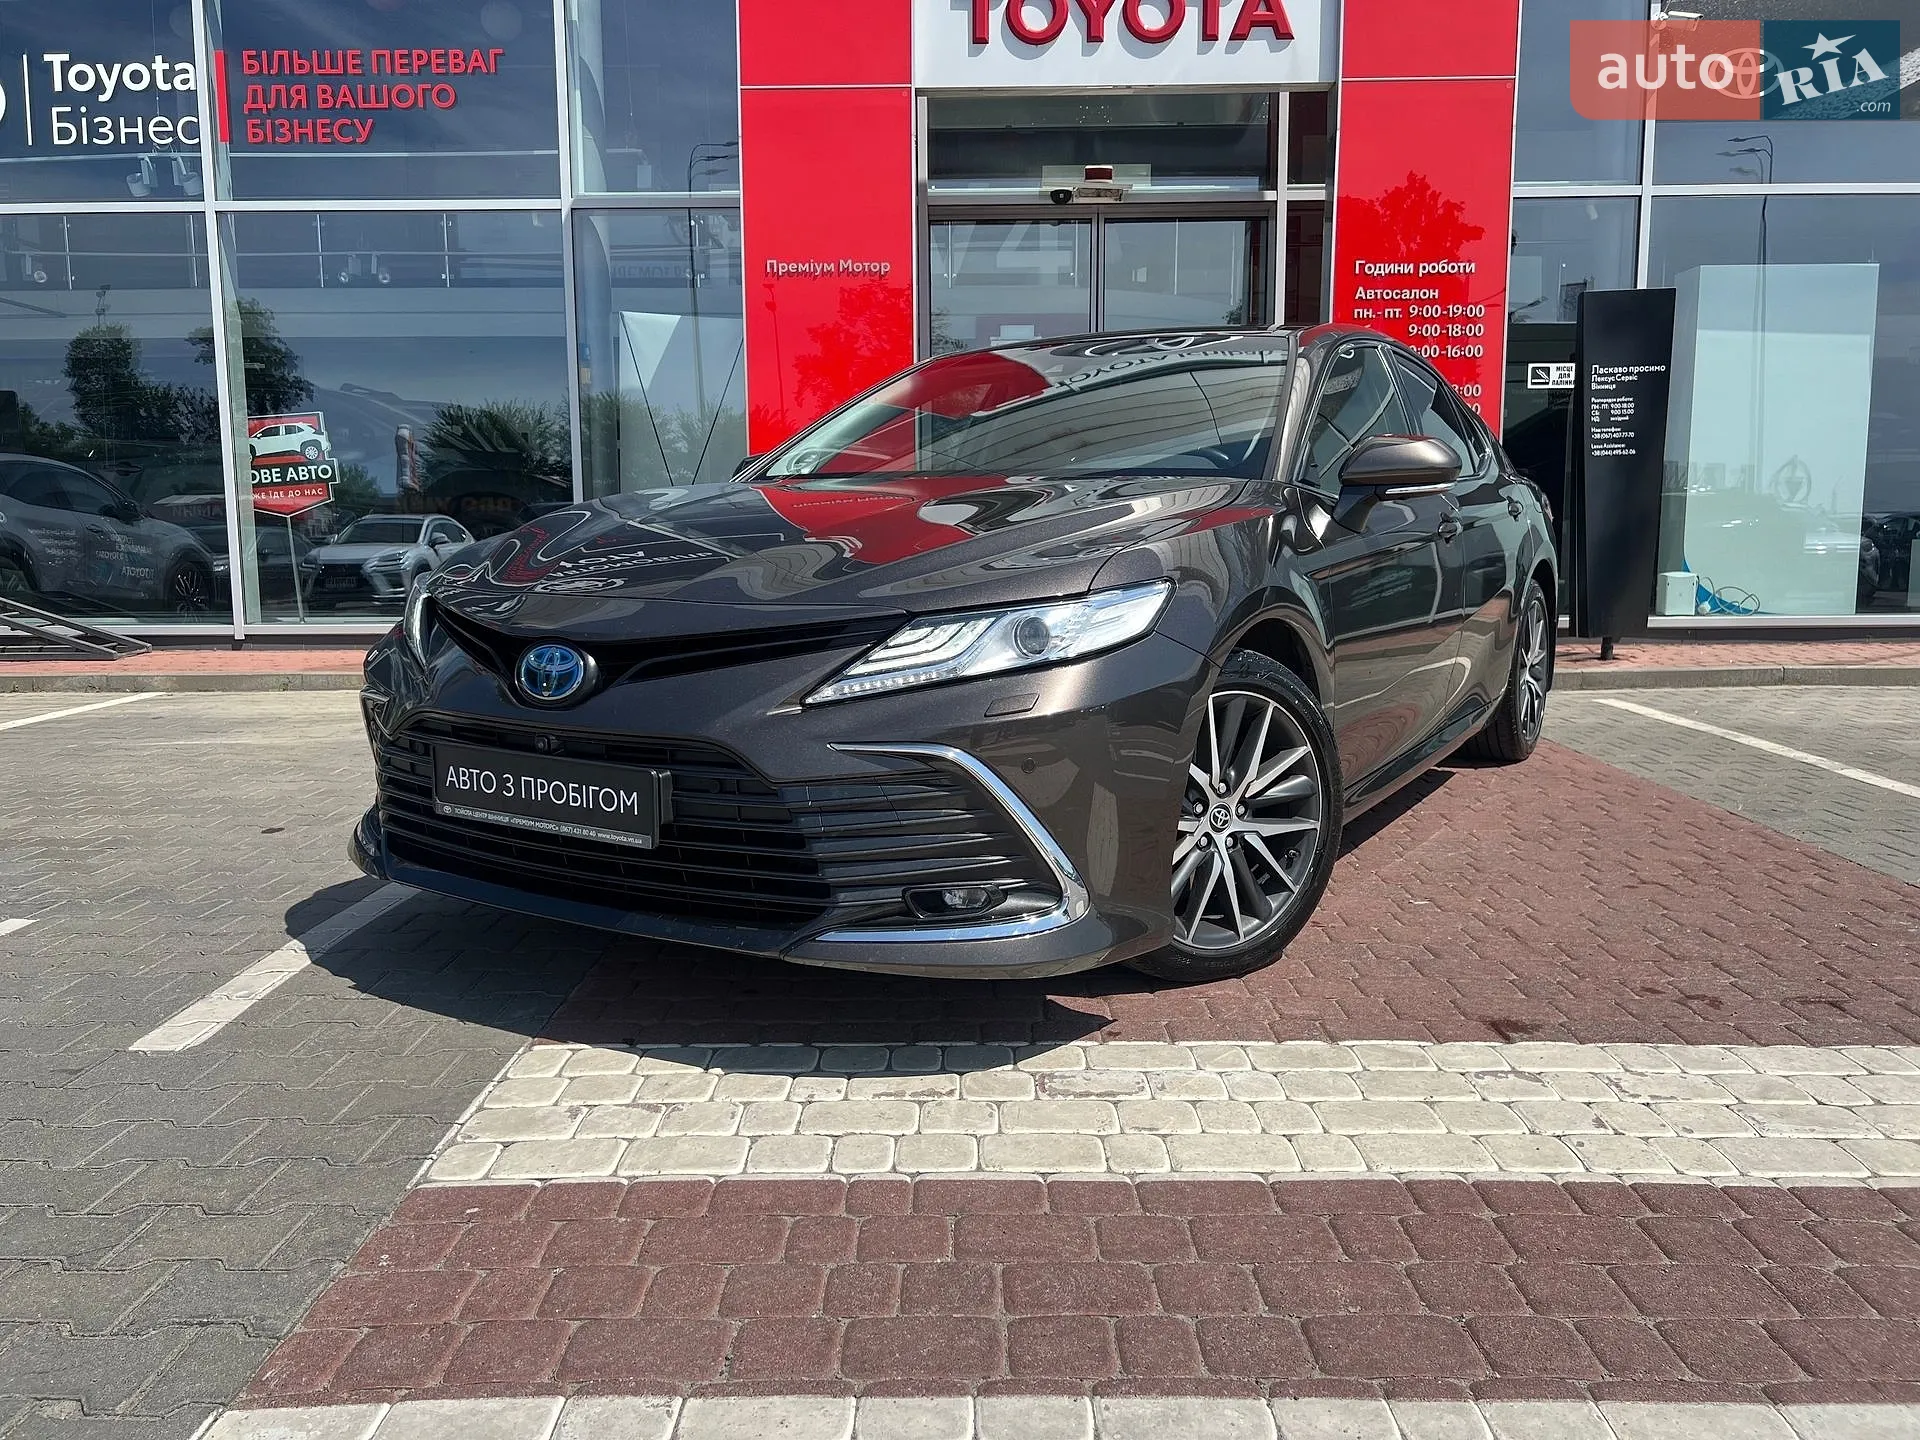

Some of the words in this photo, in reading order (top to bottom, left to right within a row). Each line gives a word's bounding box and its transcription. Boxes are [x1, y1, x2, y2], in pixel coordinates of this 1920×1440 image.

[971, 0, 1295, 46] TOYOTA
[242, 49, 363, 75] БІЛЬШЕ
[371, 48, 505, 74] ПЕРЕВАГ
[43, 53, 197, 102] Toyota
[243, 83, 308, 115] ДЛЯ
[316, 82, 457, 110] ВАШОГО
[51, 105, 200, 145] Бізнес
[246, 118, 374, 144] БІЗНЕСУ
[766, 258, 835, 276] Преміум
[839, 258, 891, 276] Мотор
[1354, 260, 1415, 277] Години
[1418, 258, 1477, 278] роботи
[1354, 286, 1440, 301] Автосалон
[1408, 304, 1486, 318] 9:00-19:00
[1407, 323, 1485, 337] 9:00-18:00
[1591, 364, 1628, 375] Ласкаво
[1628, 364, 1667, 375] просимо
[251, 468, 282, 484] ОВЕ
[286, 464, 333, 482] АВТО
[253, 491, 266, 500] ЖЕ
[288, 489, 302, 498] ДО
[304, 487, 324, 496] НАС
[445, 765, 498, 794] АВТО
[520, 775, 639, 816] ПРОБІГОМ
